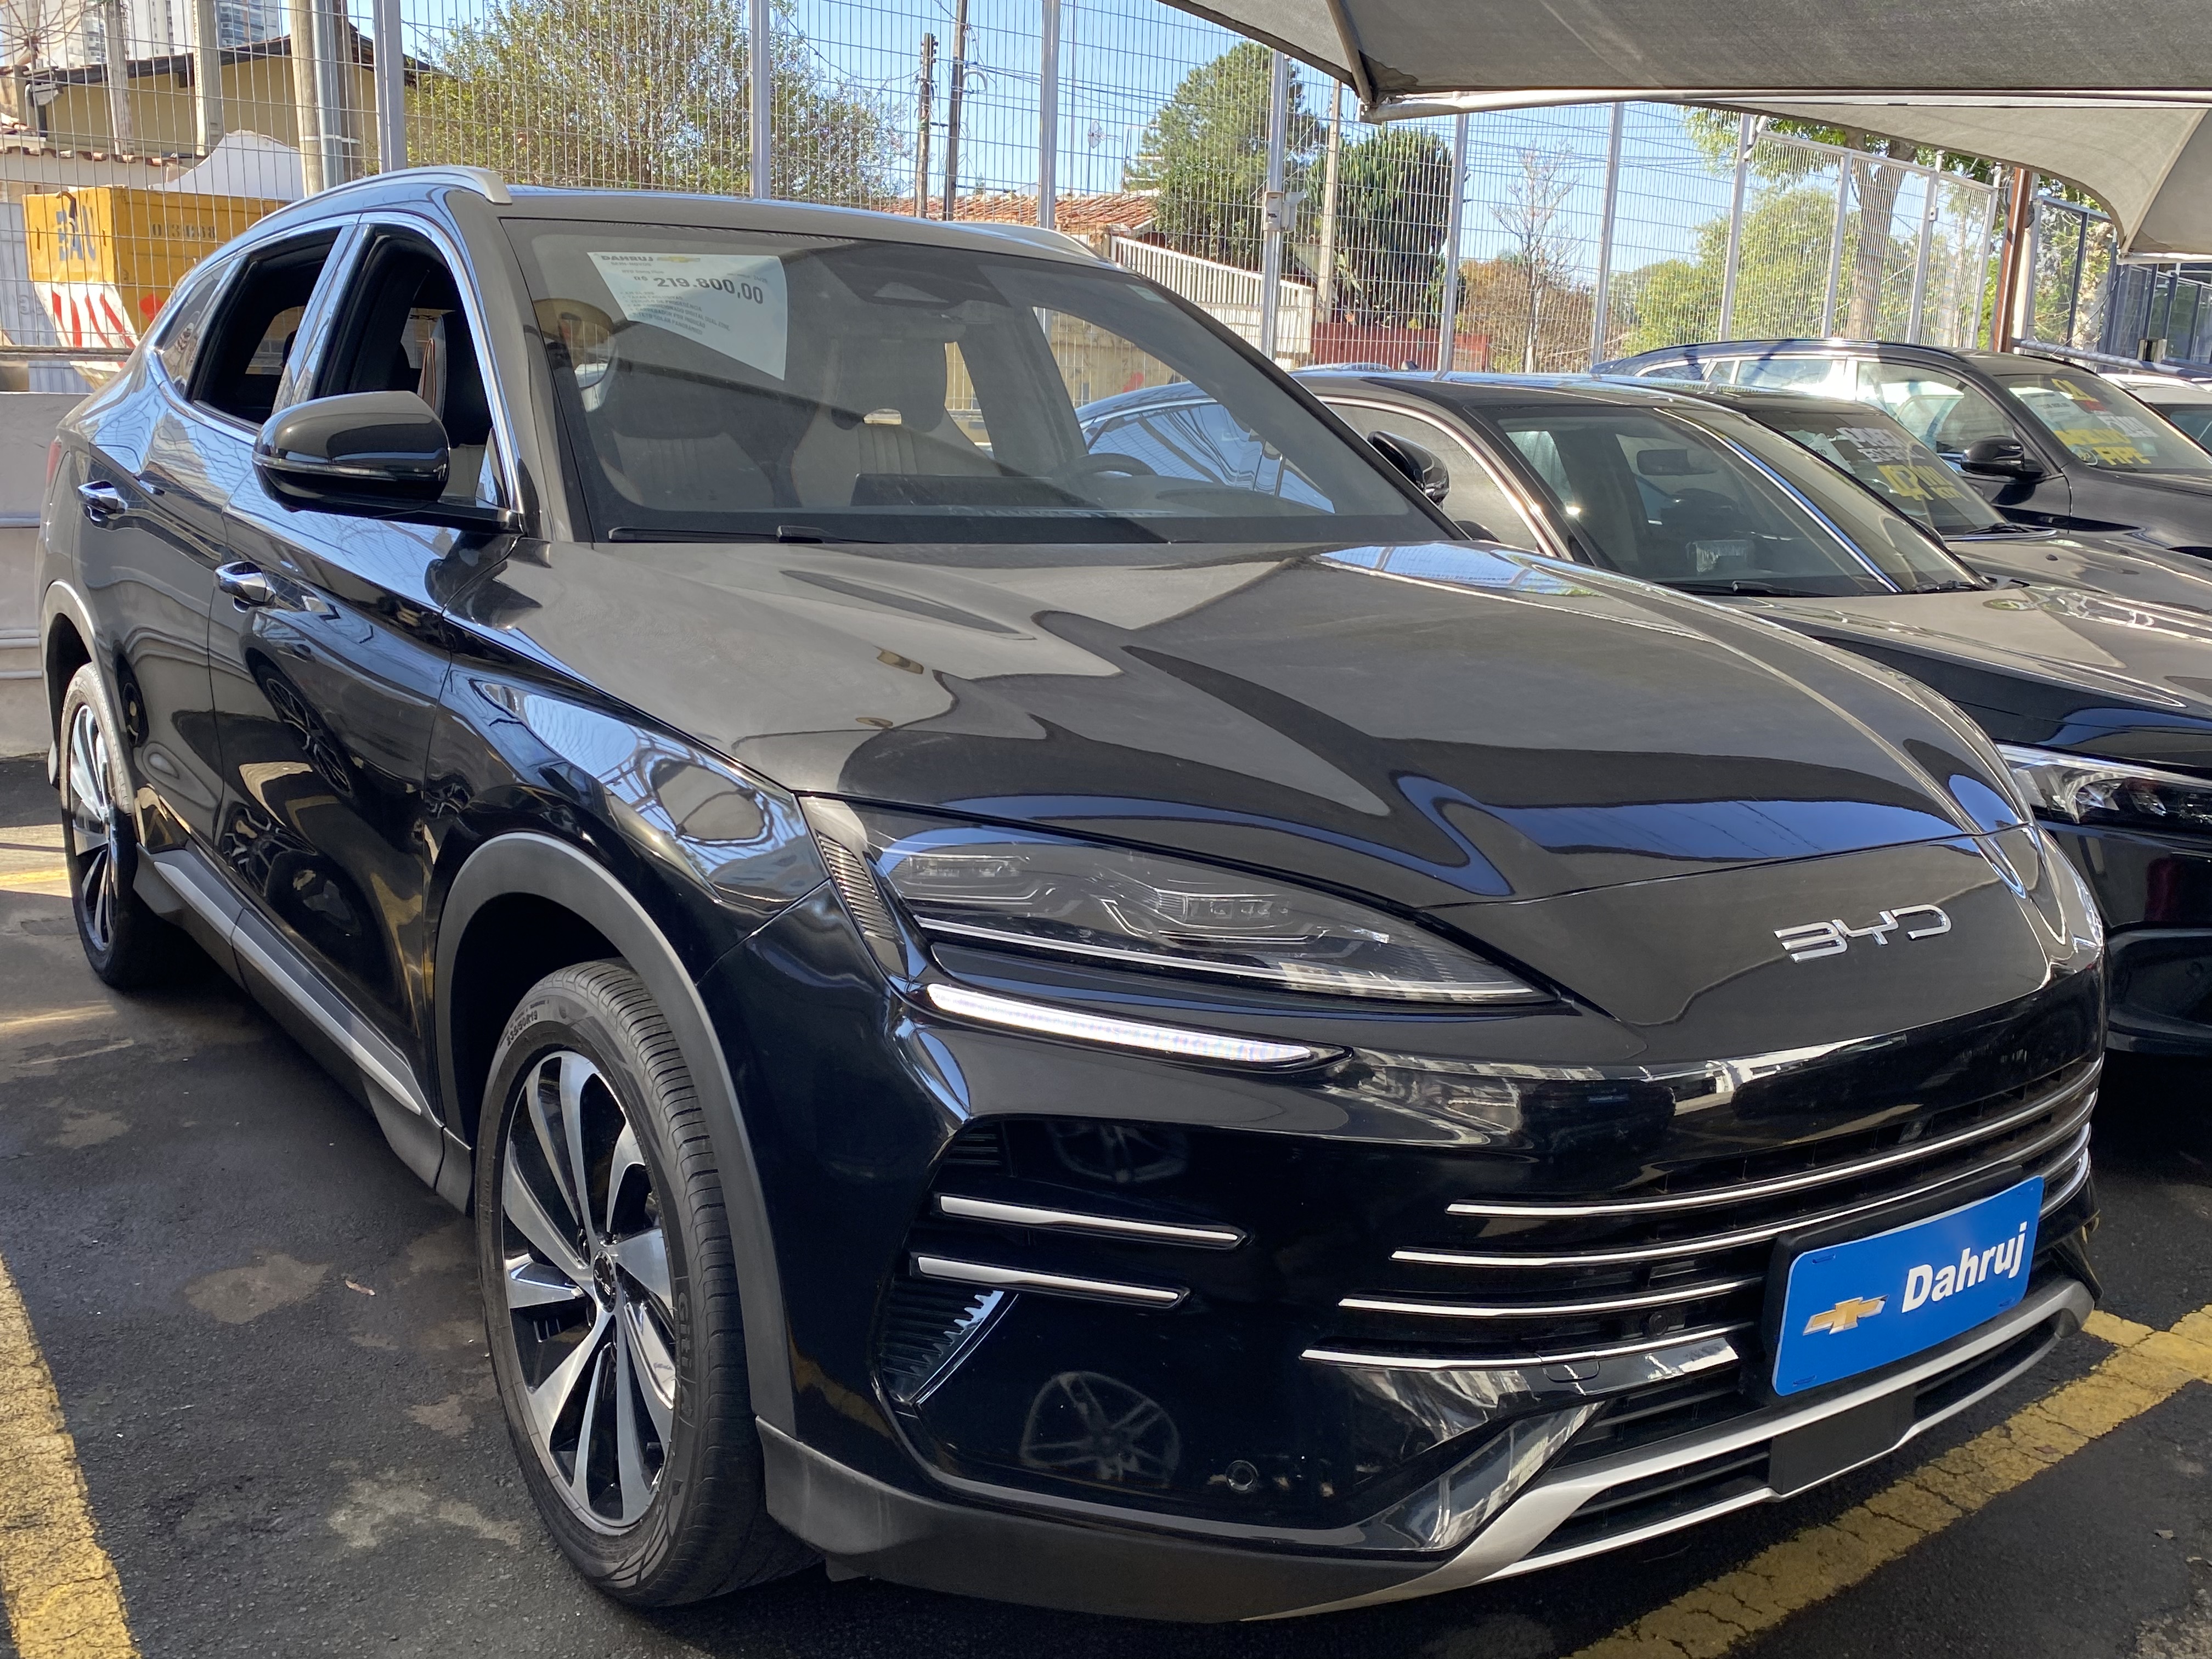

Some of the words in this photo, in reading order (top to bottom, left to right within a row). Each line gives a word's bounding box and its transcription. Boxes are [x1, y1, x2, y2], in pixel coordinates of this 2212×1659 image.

[653, 277, 764, 304] 219.800,00
[1774, 903, 1952, 963] BYD
[1901, 1221, 2028, 1313] Dahruj
